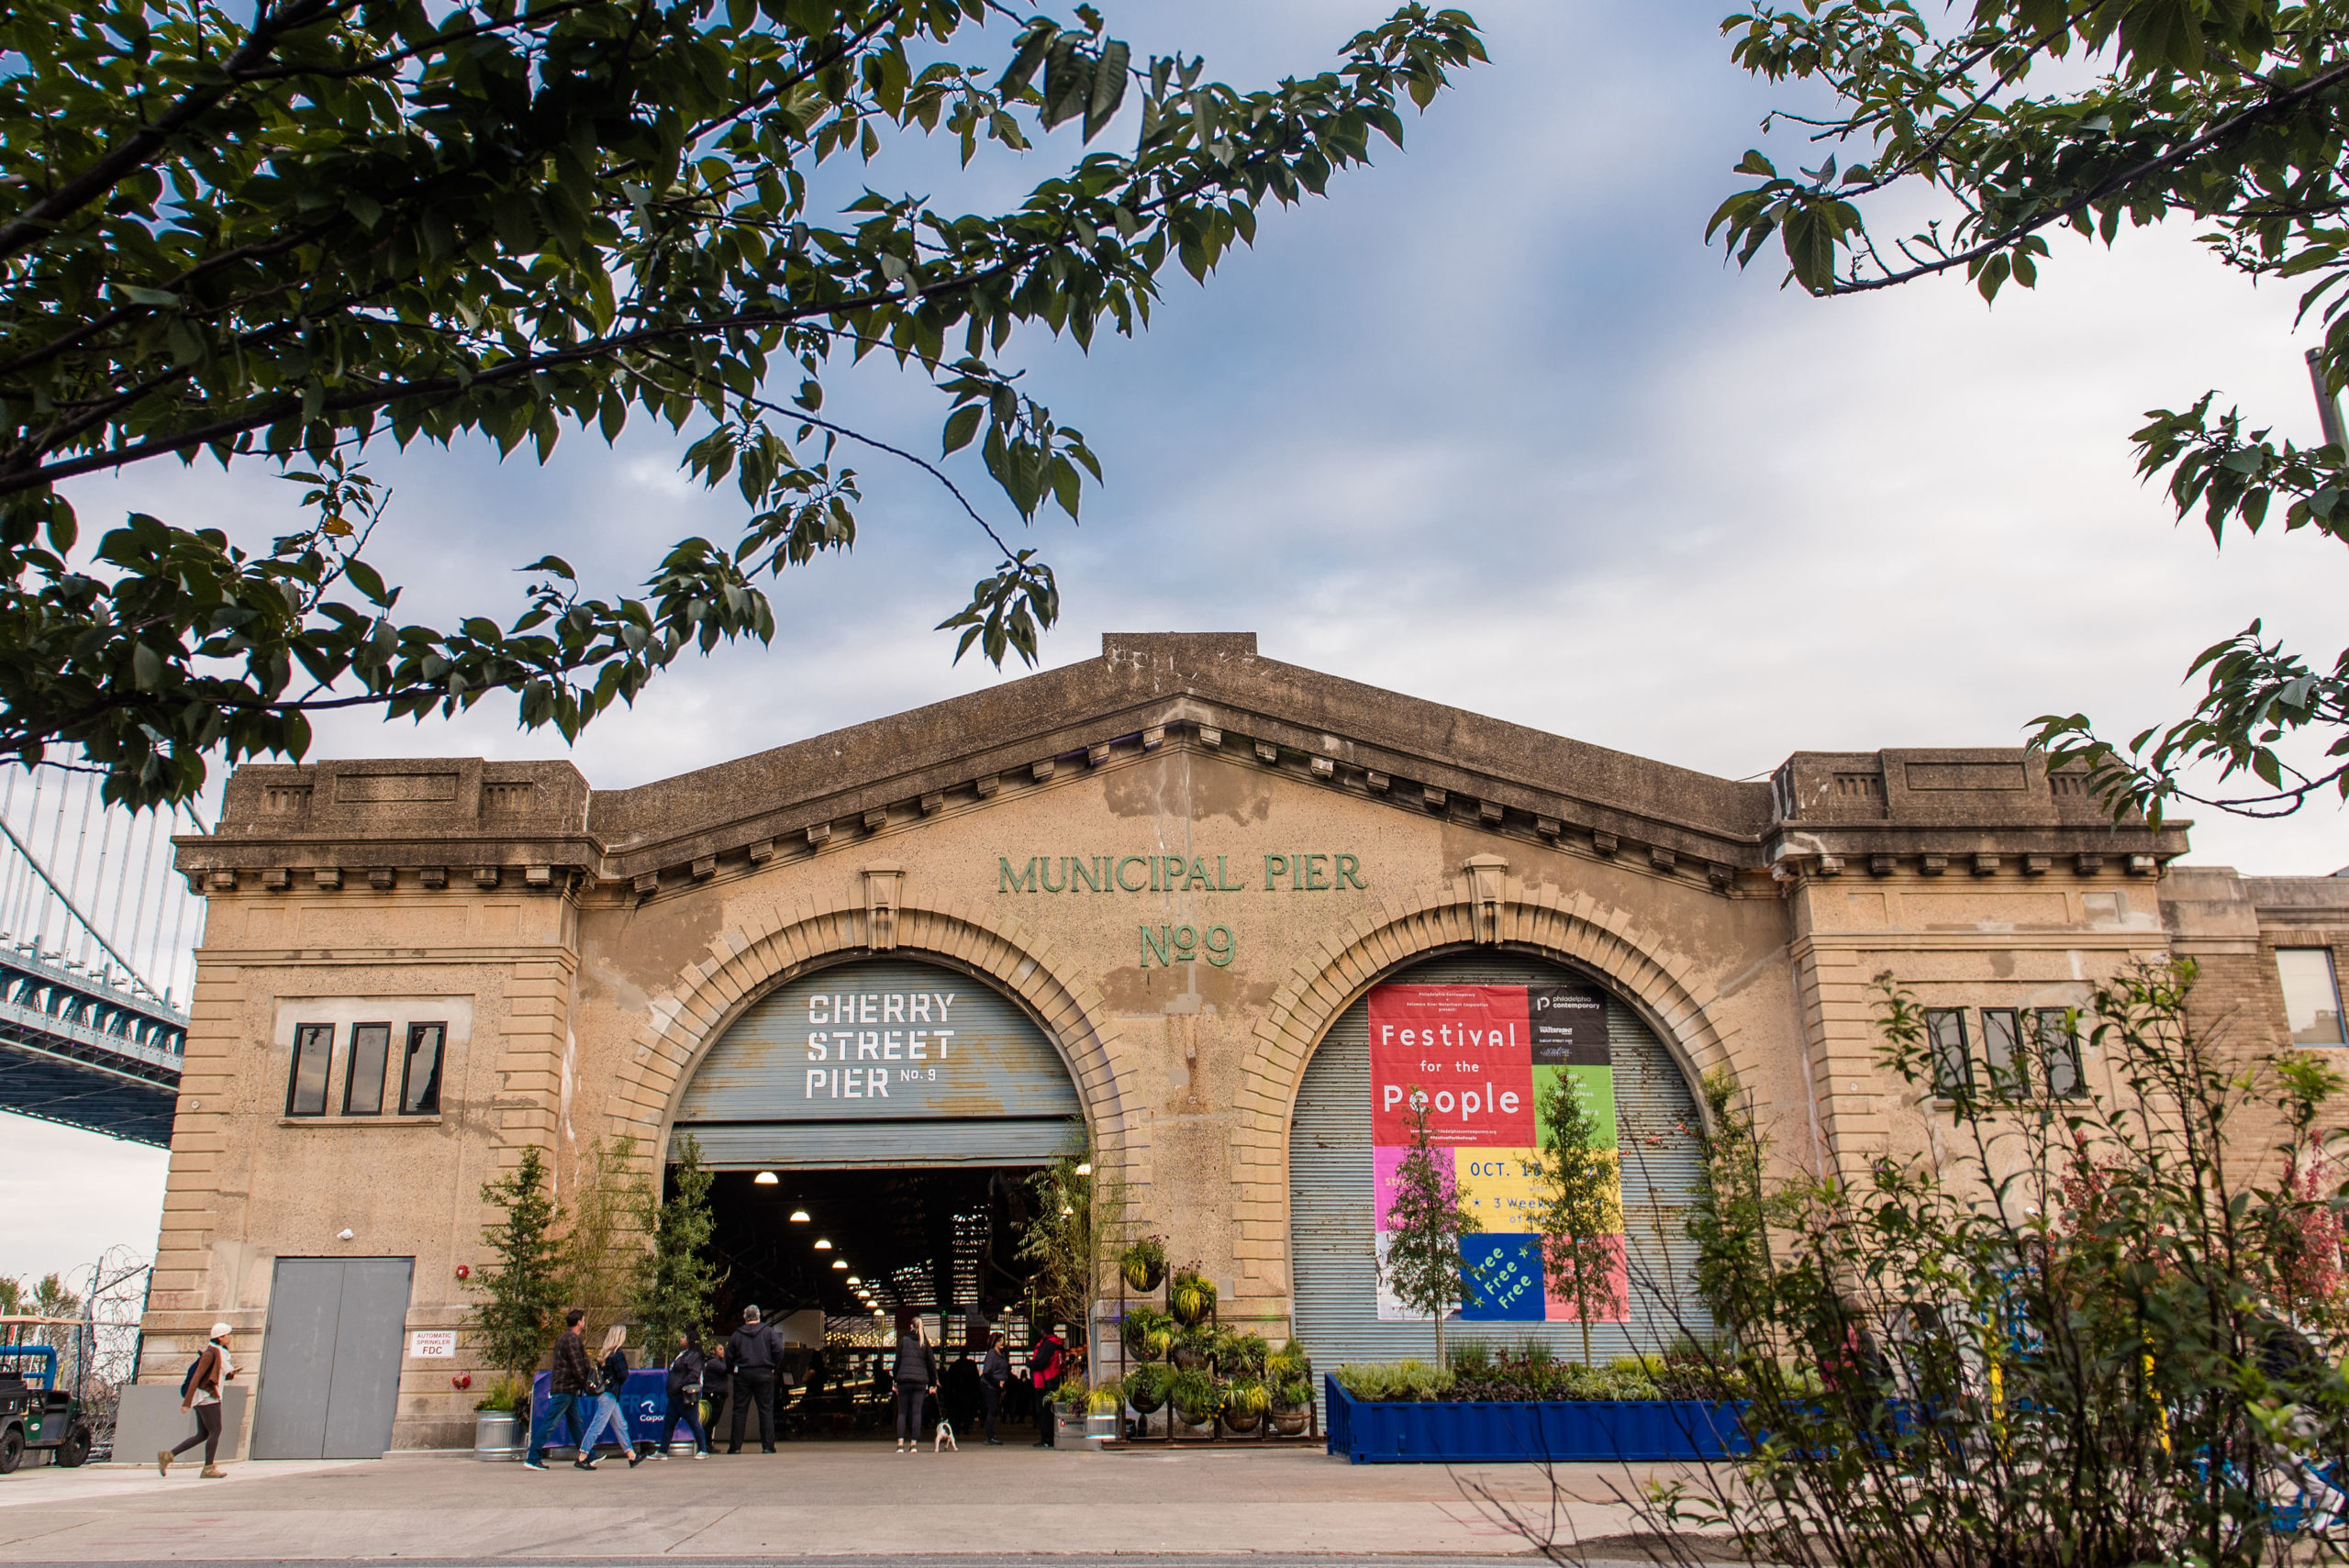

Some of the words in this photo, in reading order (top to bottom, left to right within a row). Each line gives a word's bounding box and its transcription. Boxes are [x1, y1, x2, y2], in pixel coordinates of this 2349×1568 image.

[998, 854, 1245, 893] MUNICIPAL
[1264, 852, 1368, 890] PIER
[808, 993, 955, 1024] CHERRY
[807, 1029, 954, 1061] STREET
[1419, 1060, 1442, 1073] for
[1455, 1061, 1480, 1073] the
[806, 1068, 889, 1098] PIER
[900, 1069, 924, 1082] No.
[928, 1068, 936, 1082] 9
[1384, 1082, 1520, 1121] People
[1470, 1162, 1510, 1176] OCT.
[1494, 1197, 1501, 1208] 3
[1484, 1262, 1518, 1296] Free
[1498, 1275, 1531, 1309] Free
[422, 1346, 442, 1354] FDC
